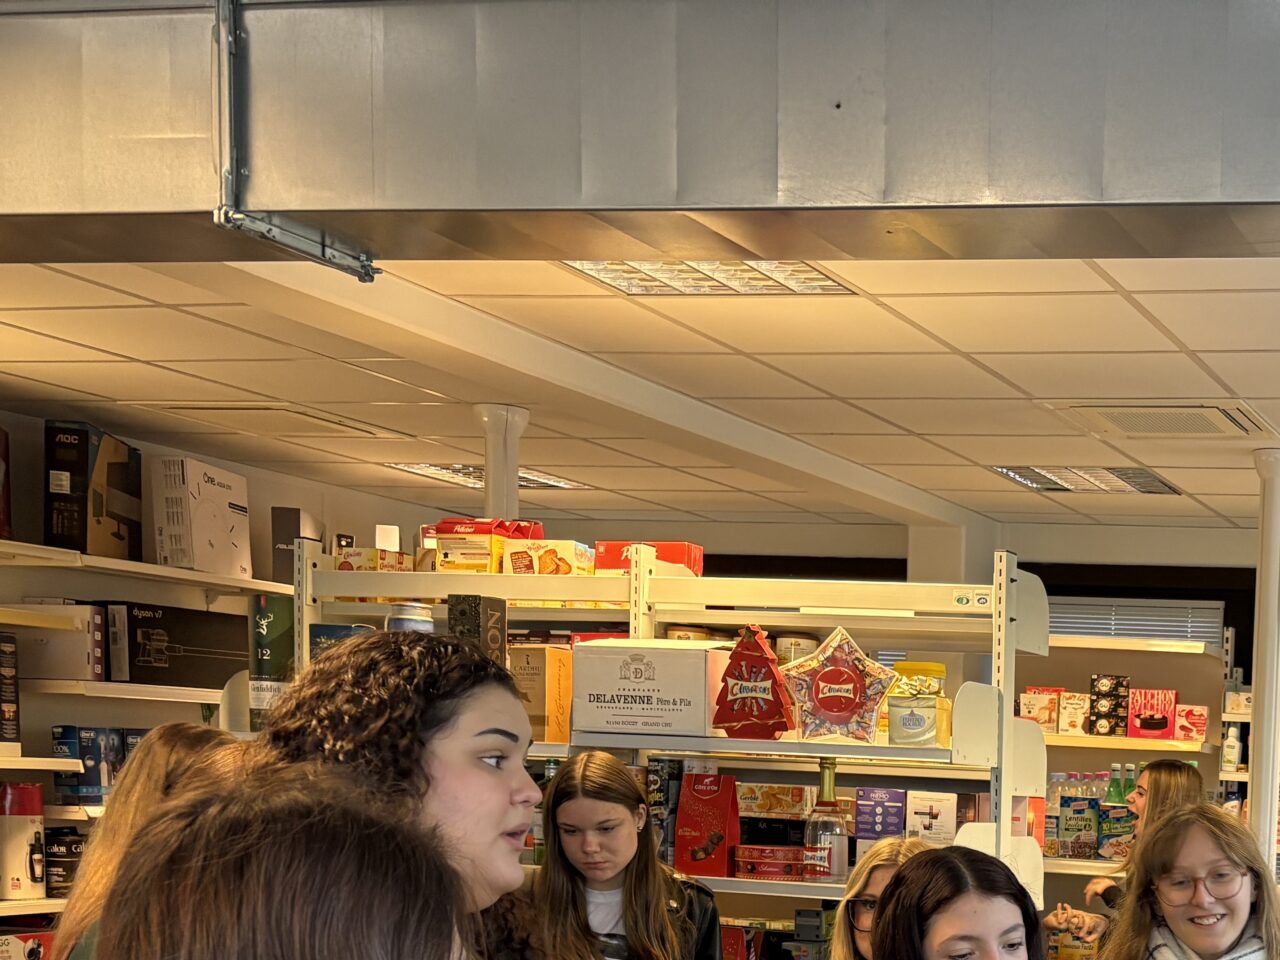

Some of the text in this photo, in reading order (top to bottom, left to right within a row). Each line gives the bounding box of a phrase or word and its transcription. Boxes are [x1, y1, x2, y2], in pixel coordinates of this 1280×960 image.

[55, 433, 79, 444] AOC
[203, 471, 215, 486] One
[132, 607, 163, 619] dyson v7
[257, 648, 271, 660] 12
[588, 693, 692, 707] DELAVENNE Père & Fils
[72, 842, 86, 852] cal
